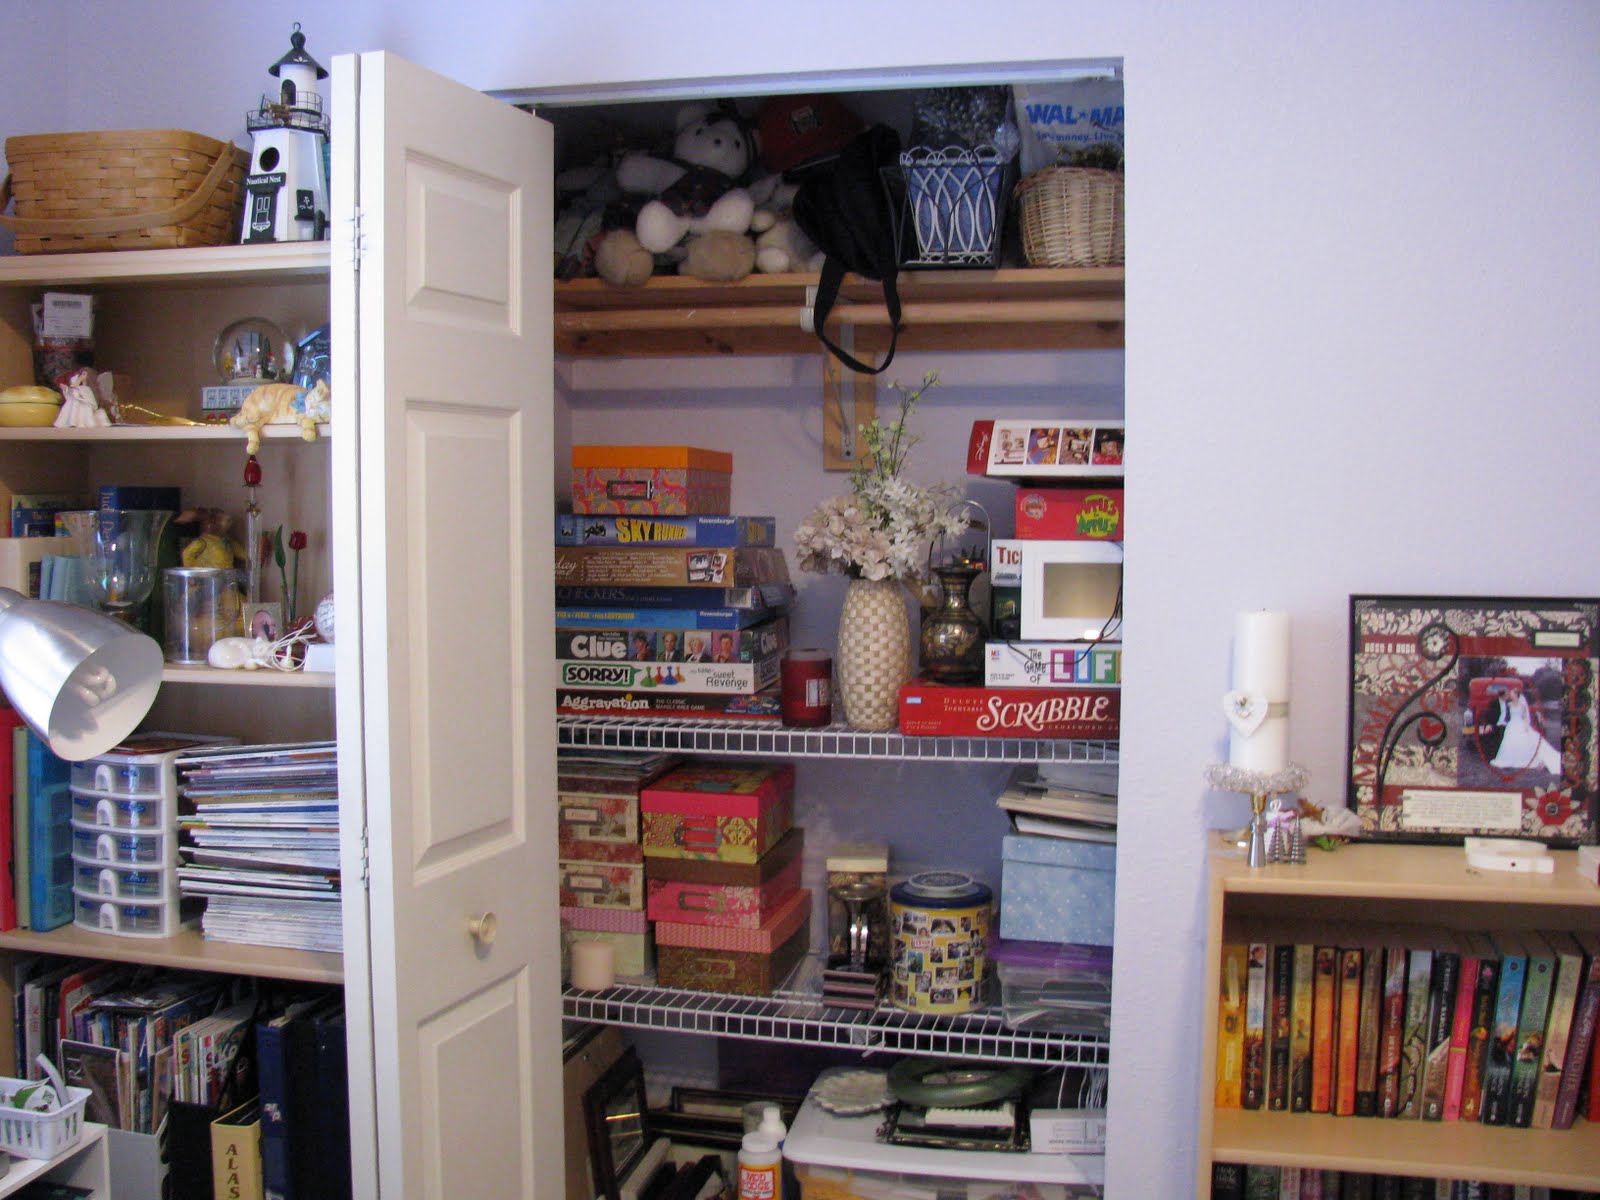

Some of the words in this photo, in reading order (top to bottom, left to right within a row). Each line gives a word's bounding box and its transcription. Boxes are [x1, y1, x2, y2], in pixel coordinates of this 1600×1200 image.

[246, 176, 269, 186] Nautical
[269, 175, 282, 184] Nest
[615, 517, 653, 543] SKY
[653, 519, 688, 541] RUNNER
[570, 634, 627, 659] Clue
[567, 667, 628, 683] SORRY!
[1053, 652, 1121, 681] LIF
[561, 693, 649, 710] Aggravation
[976, 695, 1110, 732] SCRABBLE
